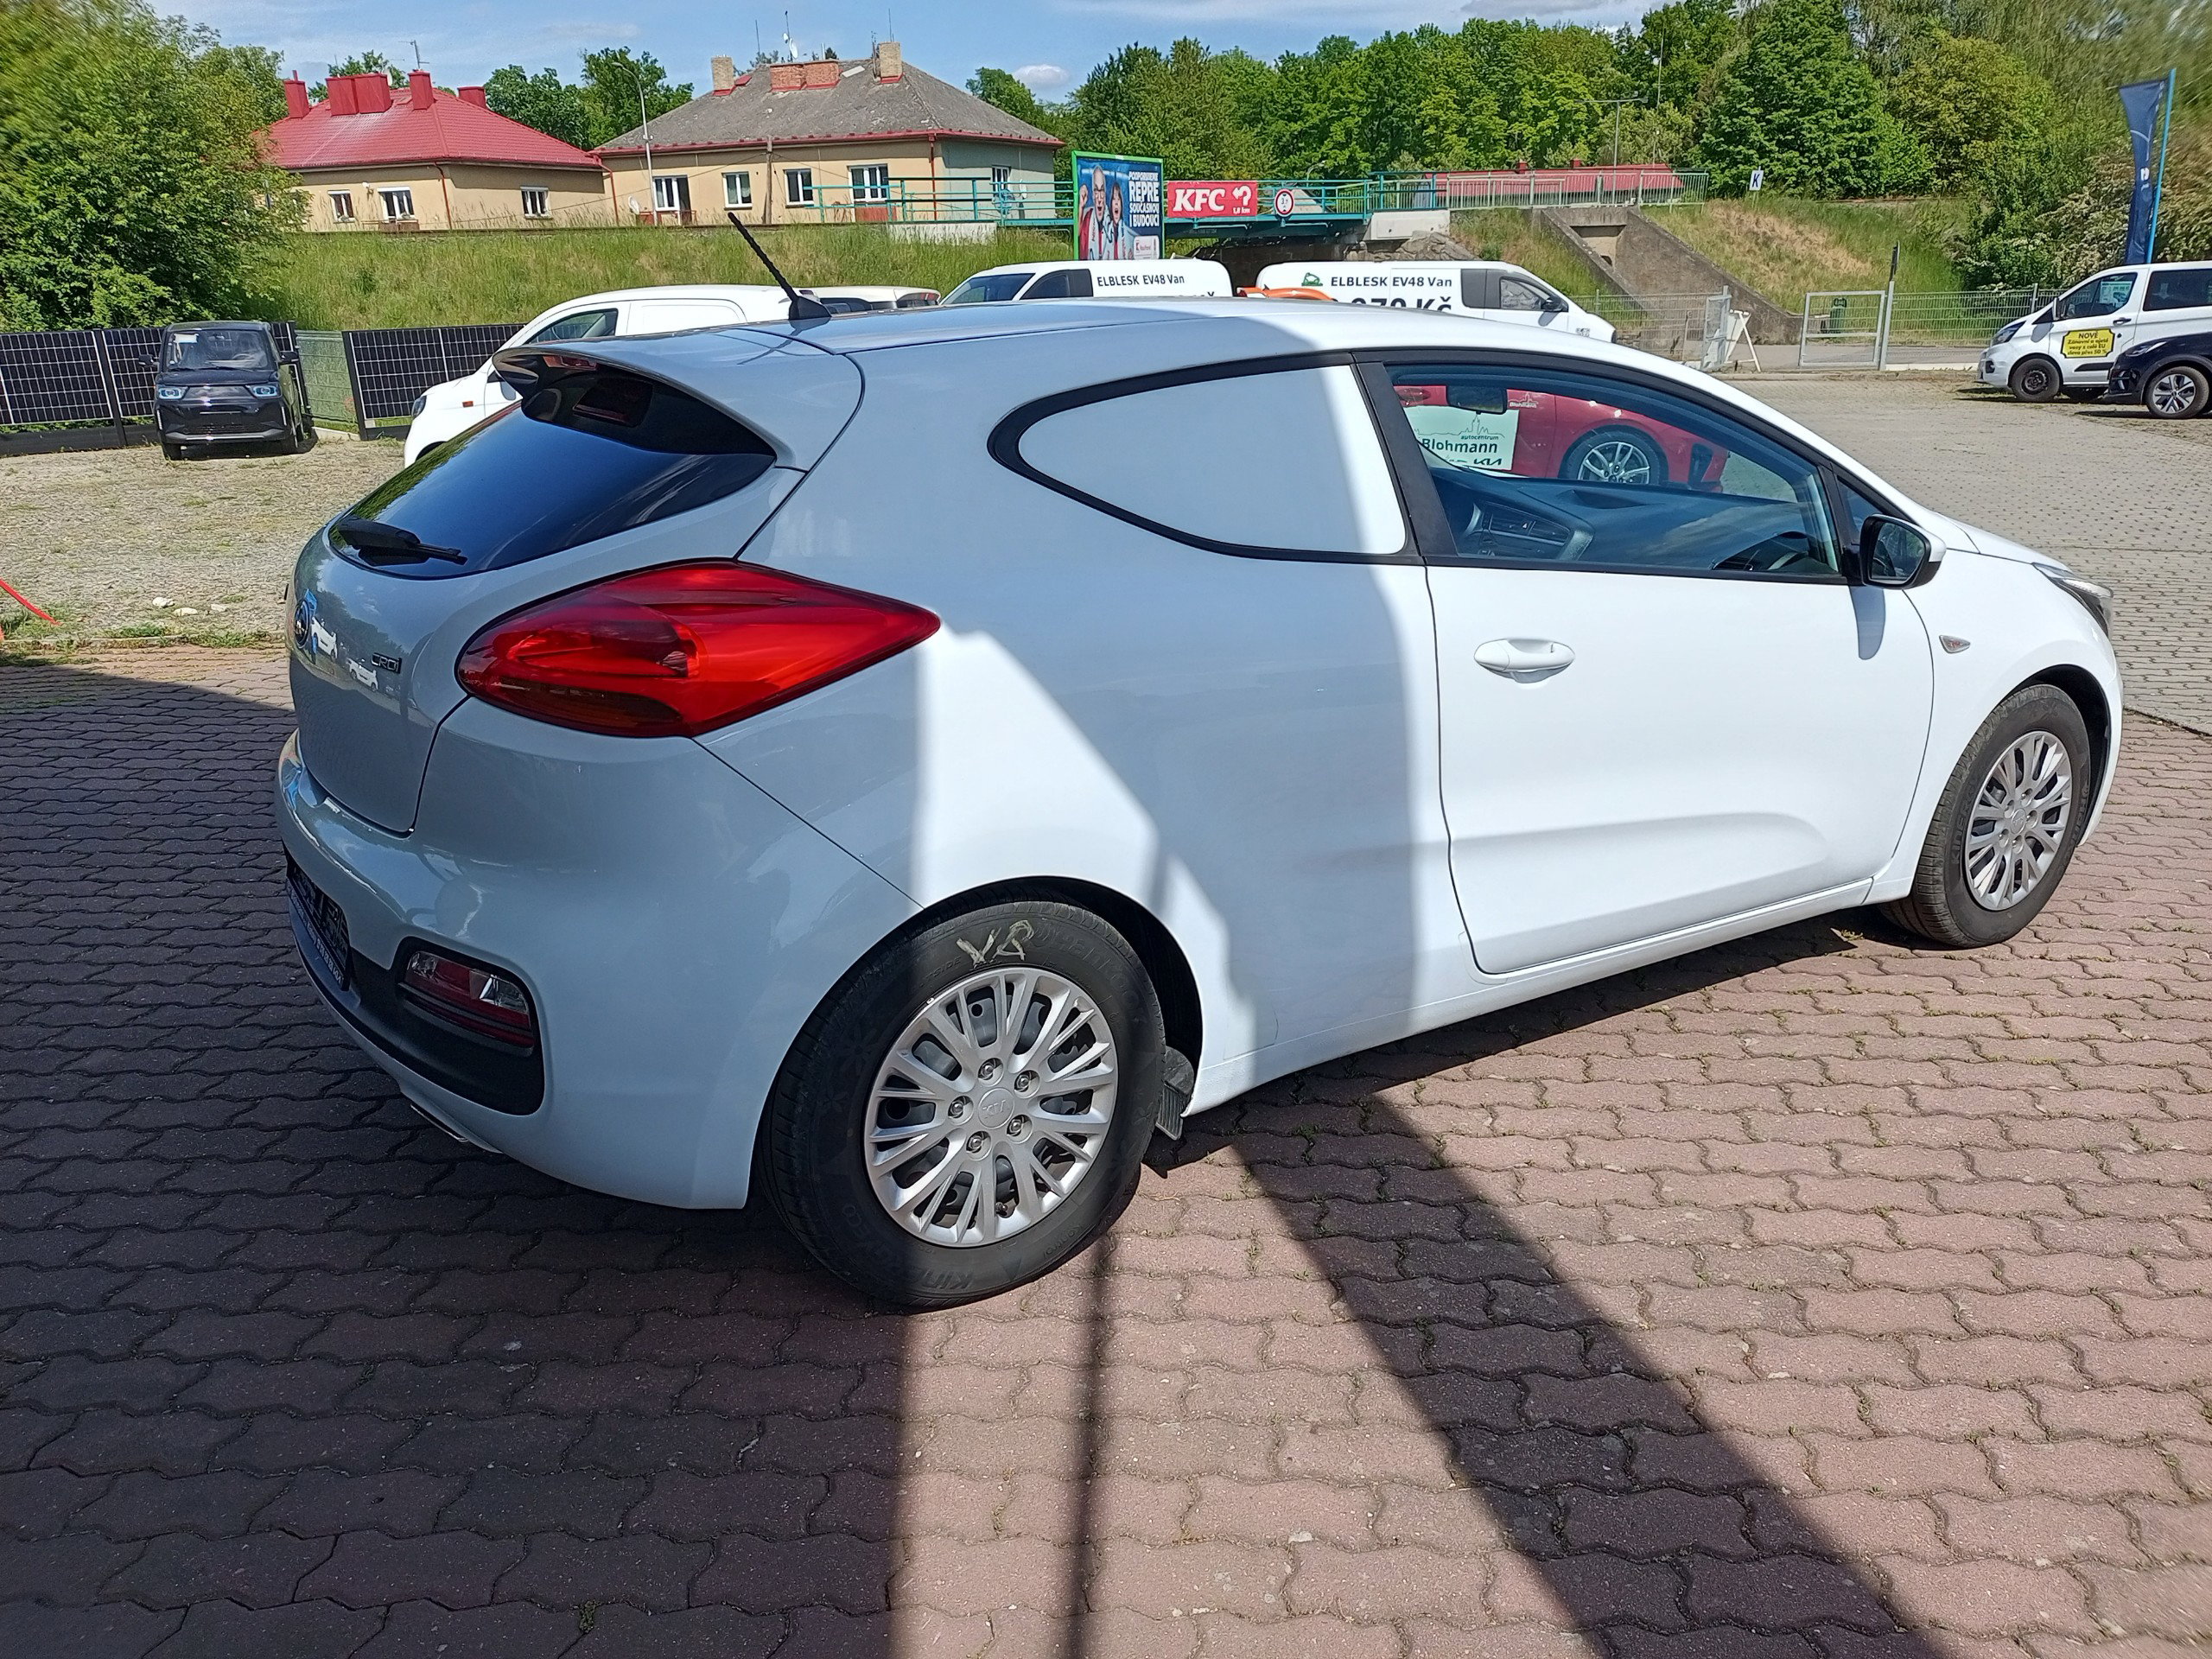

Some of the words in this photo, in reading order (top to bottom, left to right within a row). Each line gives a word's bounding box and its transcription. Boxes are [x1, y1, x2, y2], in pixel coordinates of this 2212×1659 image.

[1751, 173, 1760, 188] K
[1128, 181, 1160, 202] REPRE
[1173, 188, 1226, 212] KFC
[1097, 276, 1140, 287] ELBLESK
[1142, 275, 1166, 284] EV48
[1168, 274, 1185, 283] Van
[1331, 276, 1388, 287] ELBLESK
[1392, 276, 1424, 287] EV48
[1427, 276, 1452, 287] Van
[1422, 438, 1498, 454] Blohmann
